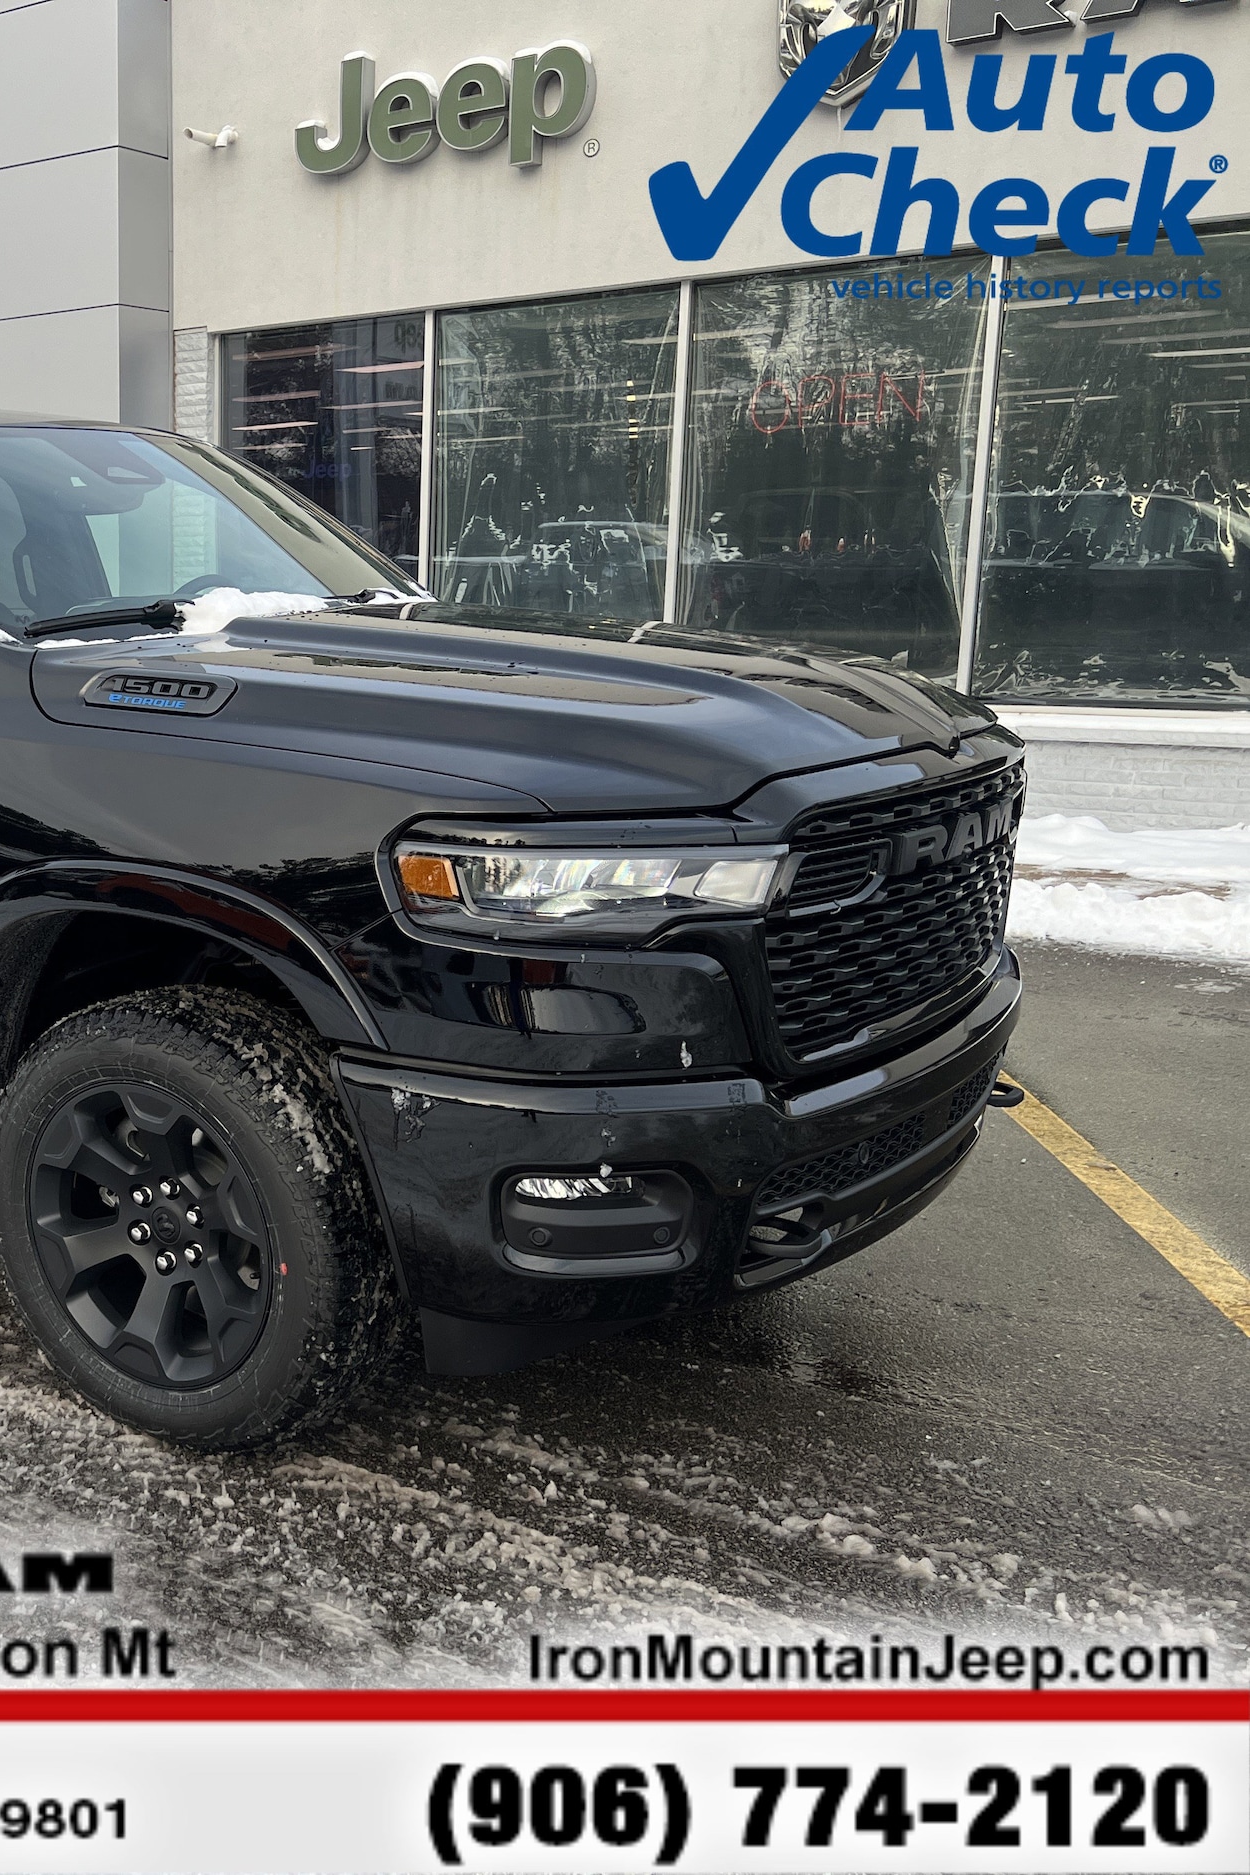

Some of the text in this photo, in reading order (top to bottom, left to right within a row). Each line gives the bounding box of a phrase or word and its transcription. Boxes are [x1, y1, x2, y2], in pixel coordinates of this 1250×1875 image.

[295, 44, 596, 177] Jeep
[752, 370, 925, 434] OPEN
[102, 677, 211, 699] 1500
[895, 797, 1013, 875] RAM
